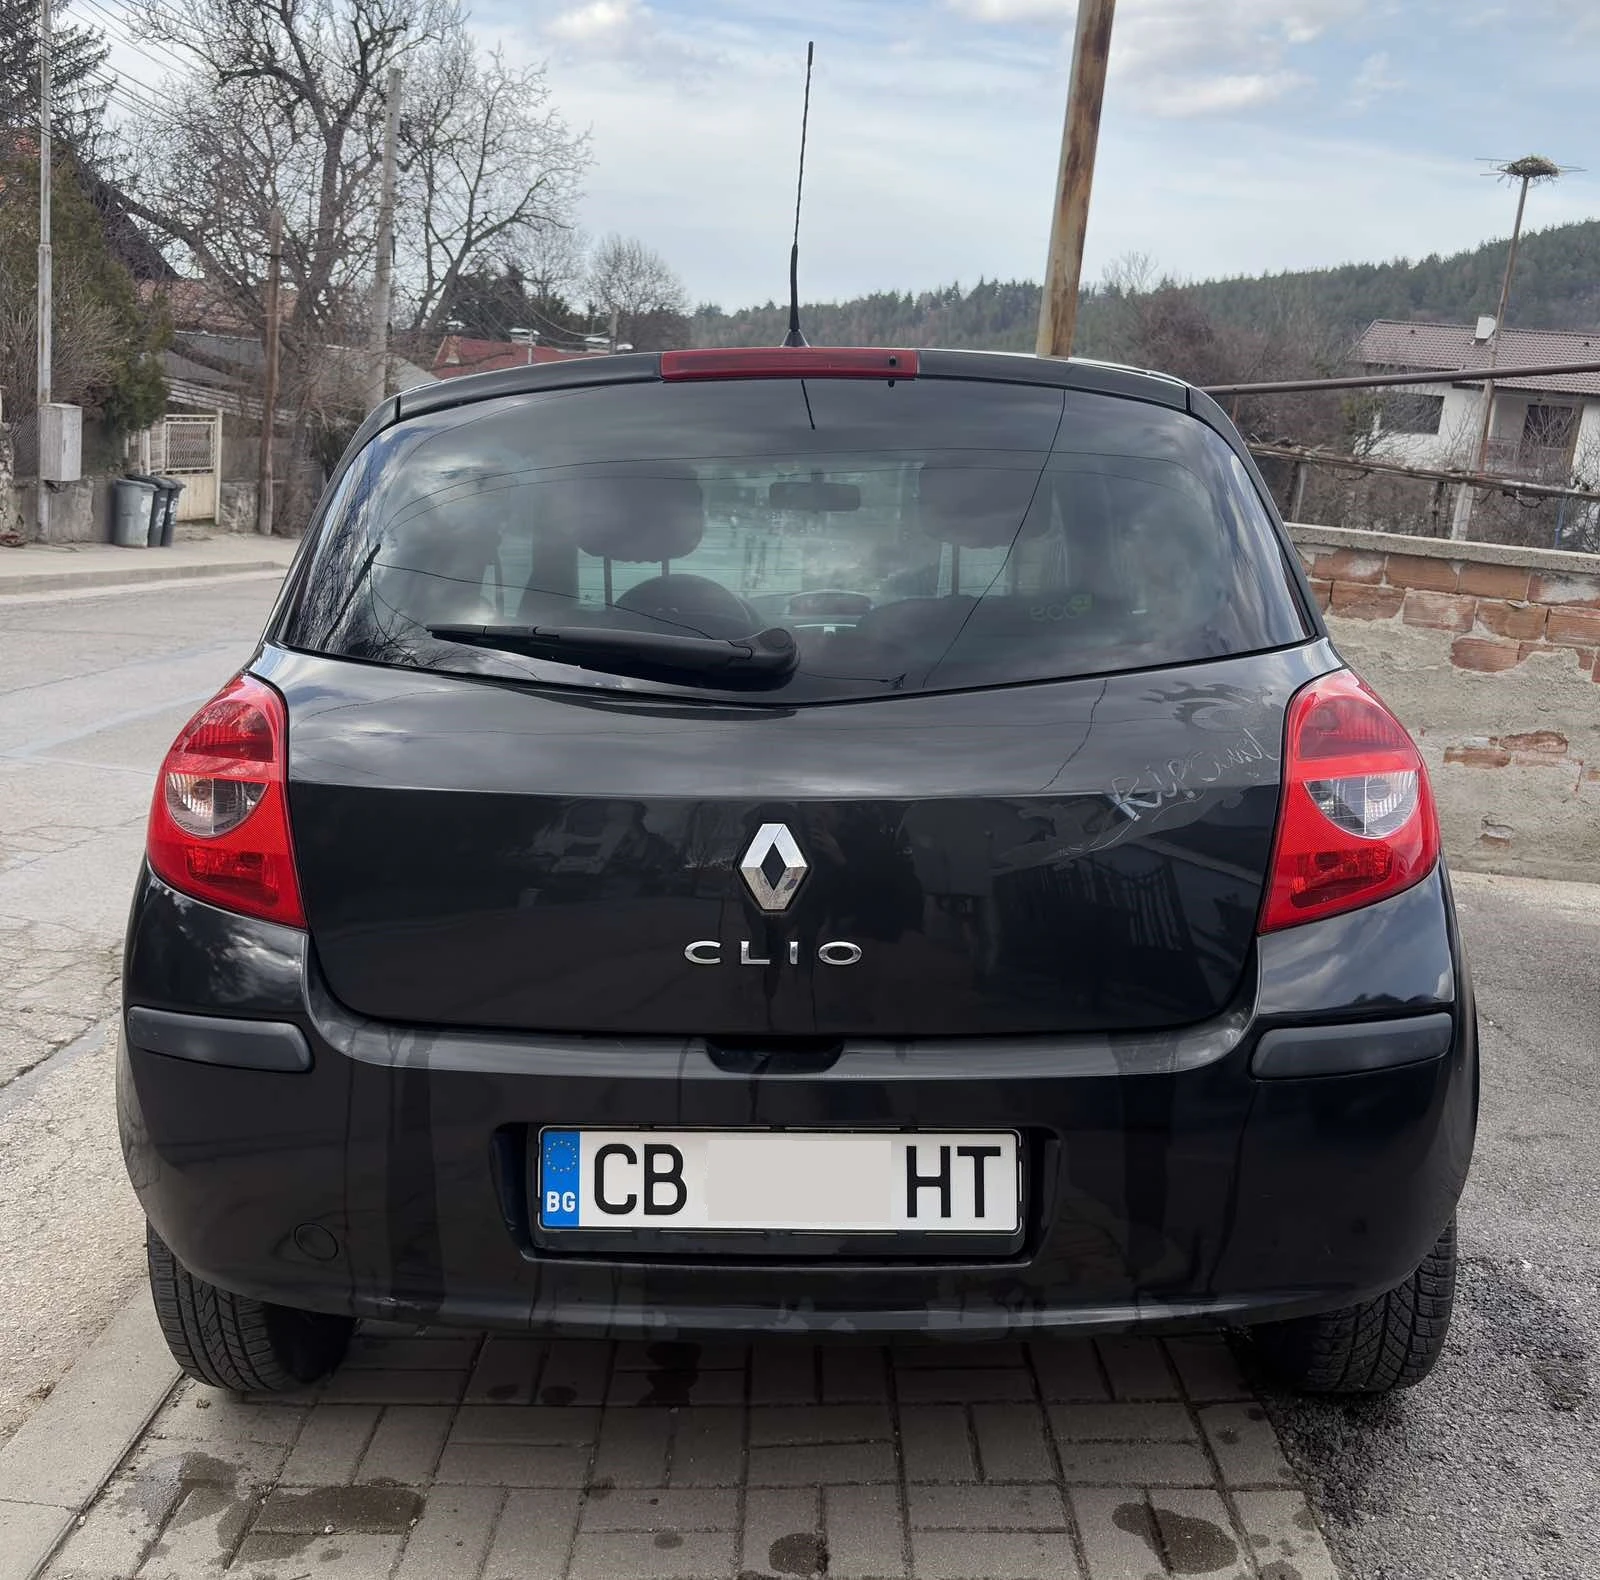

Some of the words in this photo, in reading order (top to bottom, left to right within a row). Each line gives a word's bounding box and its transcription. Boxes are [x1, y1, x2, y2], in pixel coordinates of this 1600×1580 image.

[684, 940, 862, 965] CLIO
[594, 1143, 687, 1216] CB
[906, 1145, 1001, 1218] HT
[546, 1191, 576, 1212] BG
